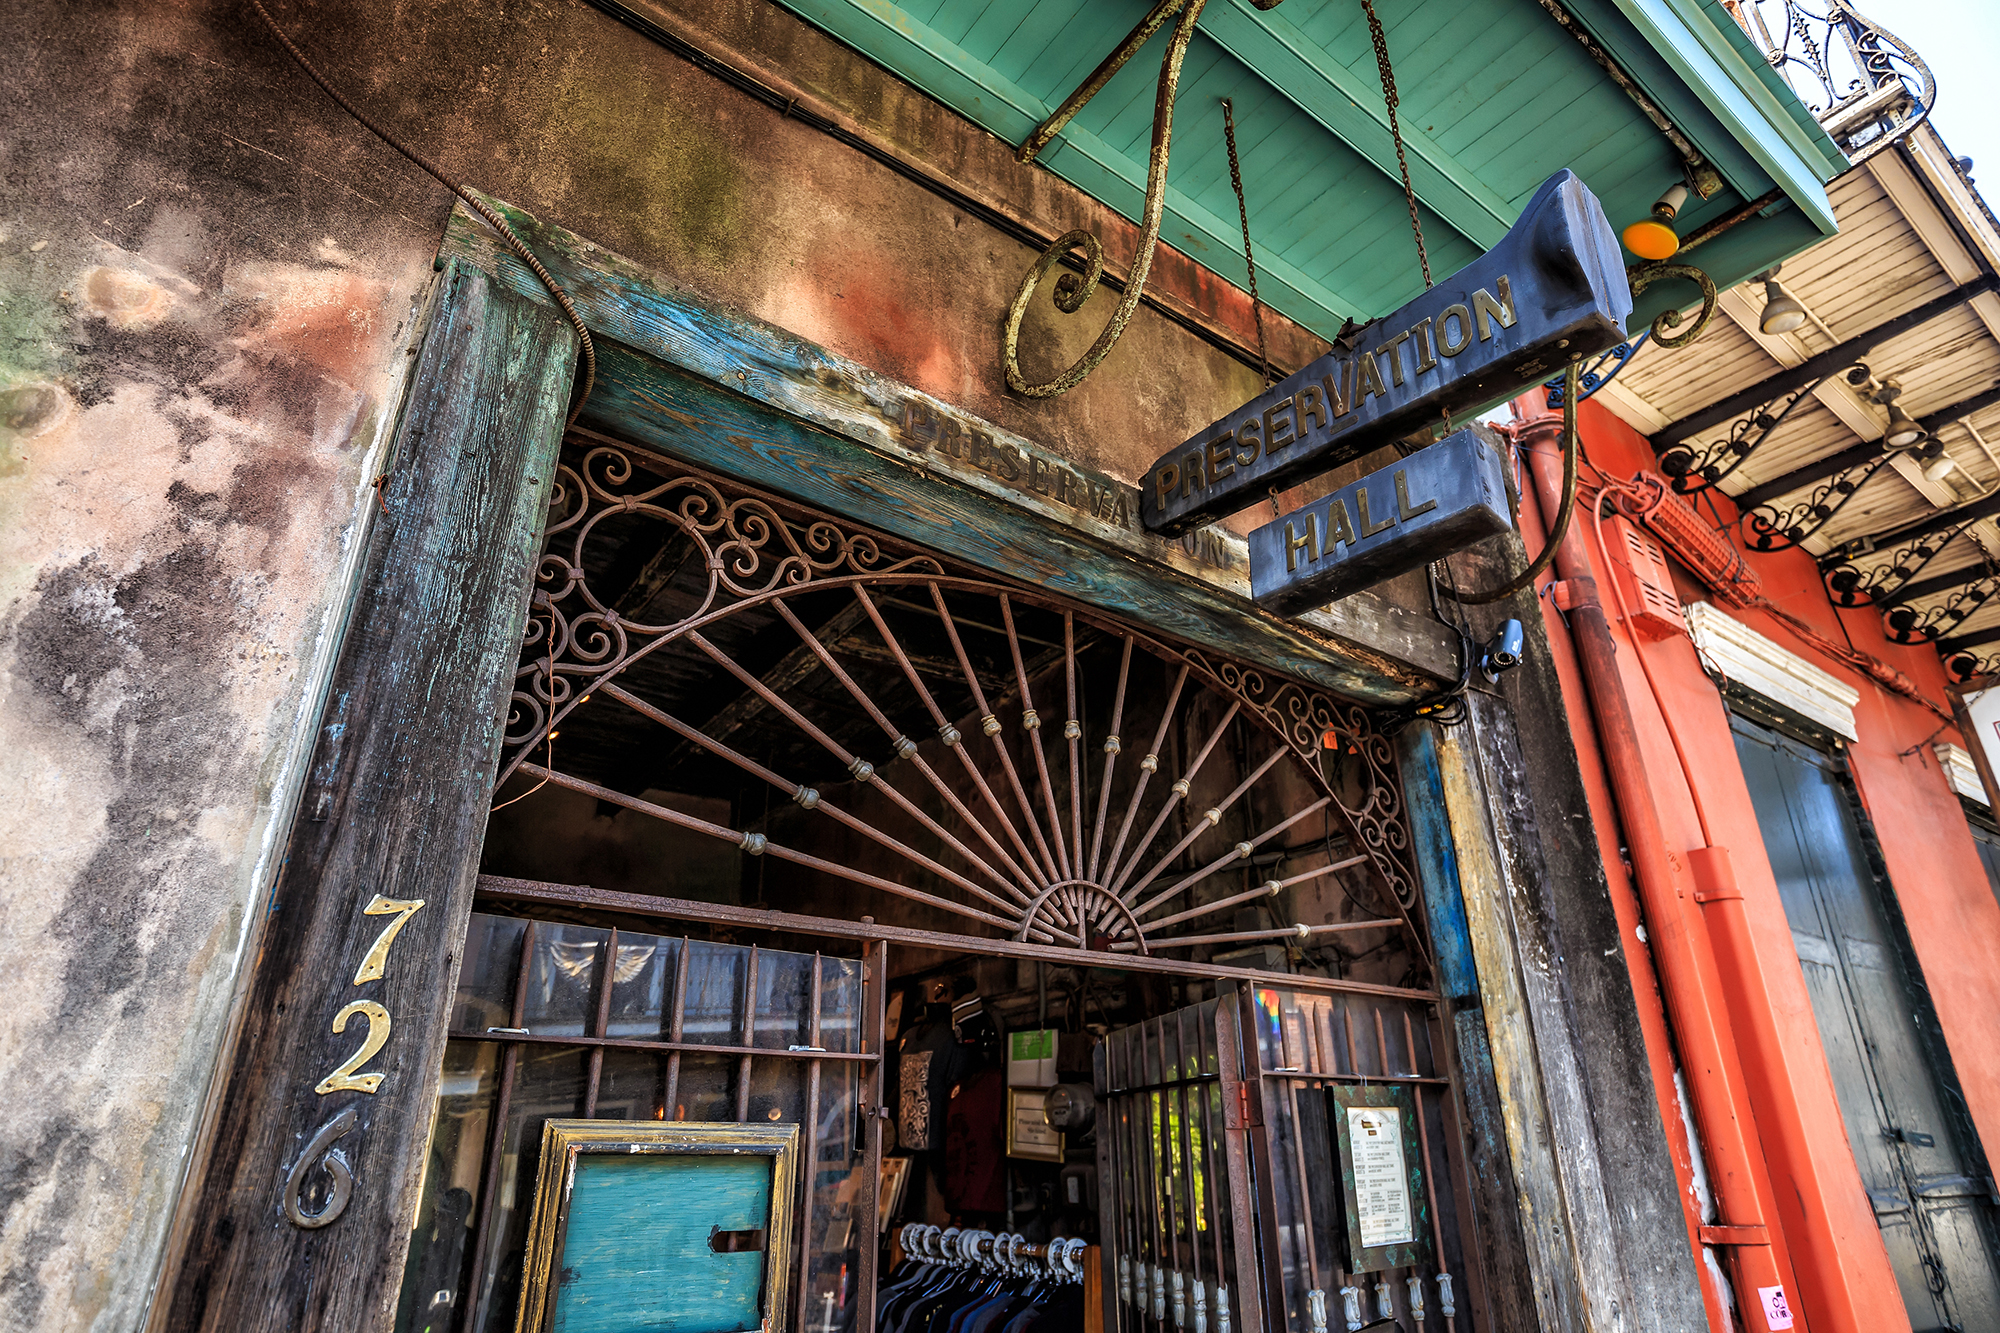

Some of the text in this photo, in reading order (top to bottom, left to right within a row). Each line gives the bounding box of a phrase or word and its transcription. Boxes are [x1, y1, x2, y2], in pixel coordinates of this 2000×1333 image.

[899, 401, 1226, 569] PRESERVAON
[1155, 274, 1518, 512] PRESERVATION
[1285, 468, 1437, 573] HALL
[283, 893, 426, 1230] 726
